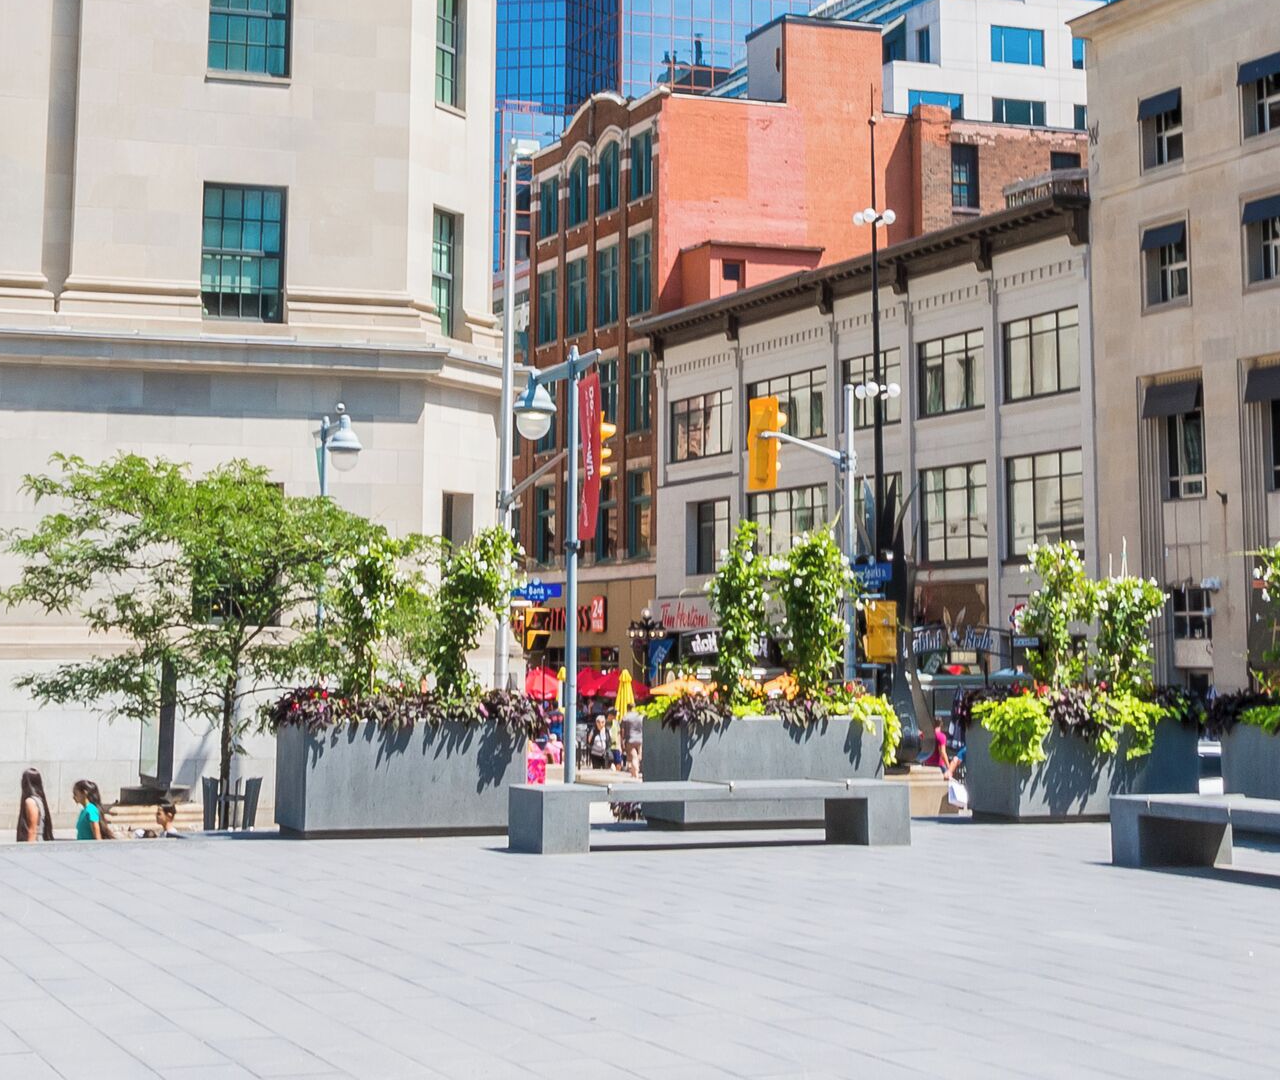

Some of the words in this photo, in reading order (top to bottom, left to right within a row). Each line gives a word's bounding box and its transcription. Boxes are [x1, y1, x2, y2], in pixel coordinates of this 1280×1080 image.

[528, 585, 544, 595] Bank
[592, 599, 604, 618] 24
[661, 603, 675, 627] Tim
[675, 601, 709, 628] Hortons
